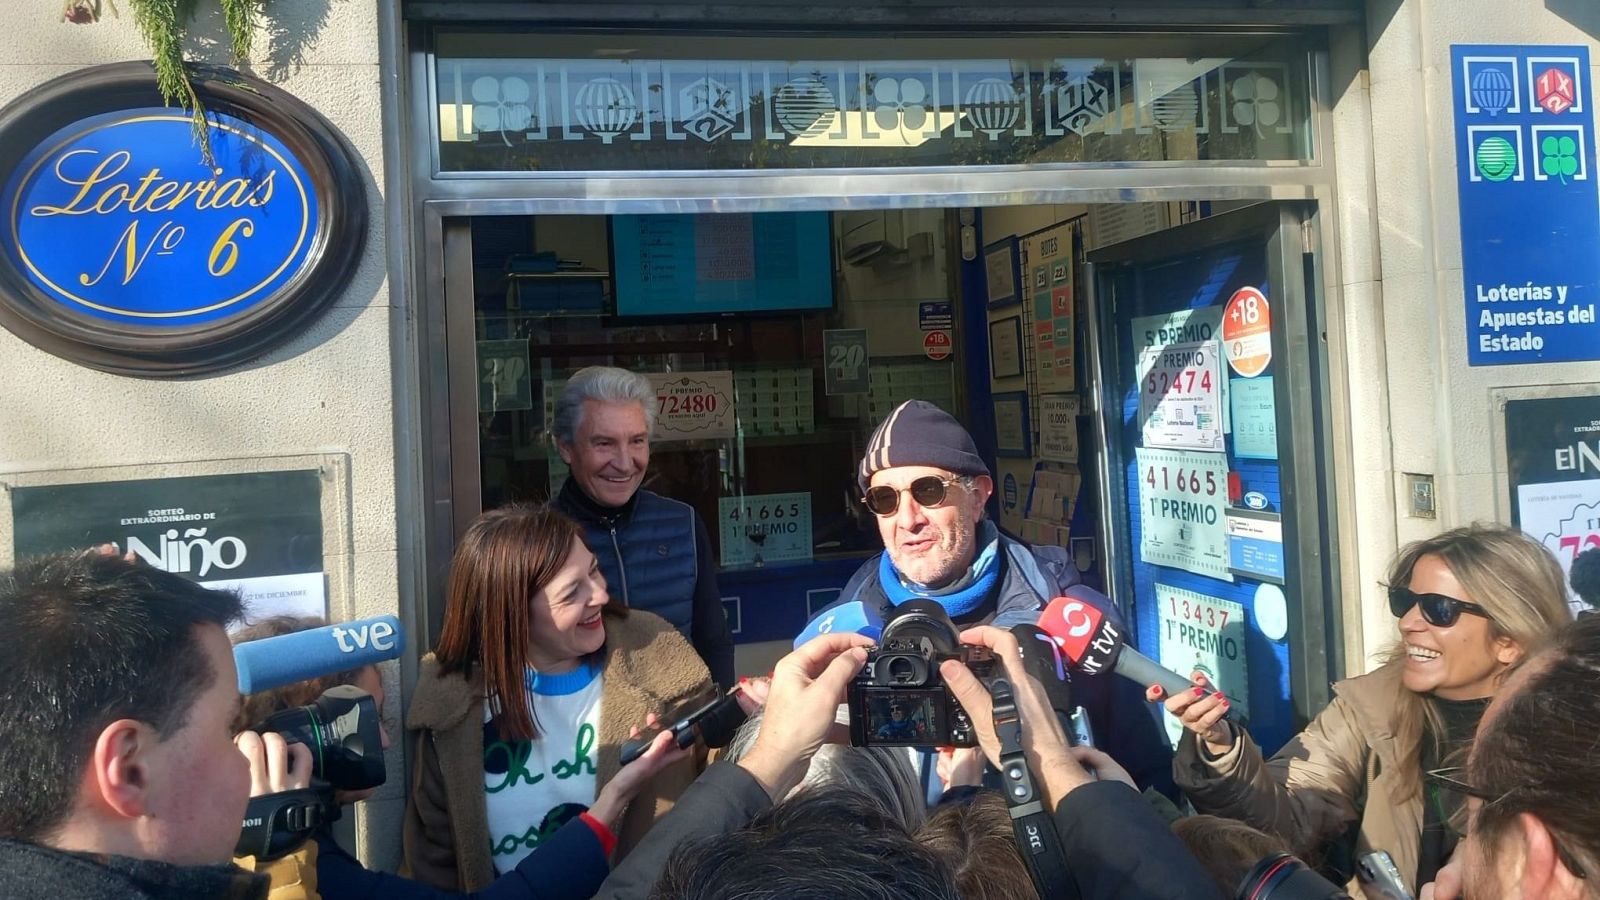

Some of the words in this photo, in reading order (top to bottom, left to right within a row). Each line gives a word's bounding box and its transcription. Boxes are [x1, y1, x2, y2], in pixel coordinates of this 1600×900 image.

[31, 150, 276, 217] Loterias
[208, 217, 254, 277] 6
[1477, 281, 1553, 302] Loterías
[1556, 285, 1568, 305] y
[1231, 296, 1259, 326] +18
[1479, 307, 1565, 332] Apuestas
[1568, 304, 1595, 324] del
[1158, 322, 1212, 345] PREMIO
[1480, 332, 1544, 353] Estado
[1164, 351, 1204, 368] PREMIO
[1149, 370, 1211, 394] 52474
[657, 394, 717, 415] 72480
[1147, 466, 1216, 496] 41665
[120, 513, 201, 525] EXTRAORDINARIO
[203, 512, 216, 520] DE
[148, 508, 184, 517] SORTEO
[729, 503, 799, 521] 41665
[1161, 498, 1217, 525] PREMIO
[745, 522, 798, 537] PREMIO
[127, 527, 247, 577] Niño
[1170, 597, 1229, 630] 13437
[332, 621, 394, 653] tve
[1179, 622, 1238, 661] PREMIO
